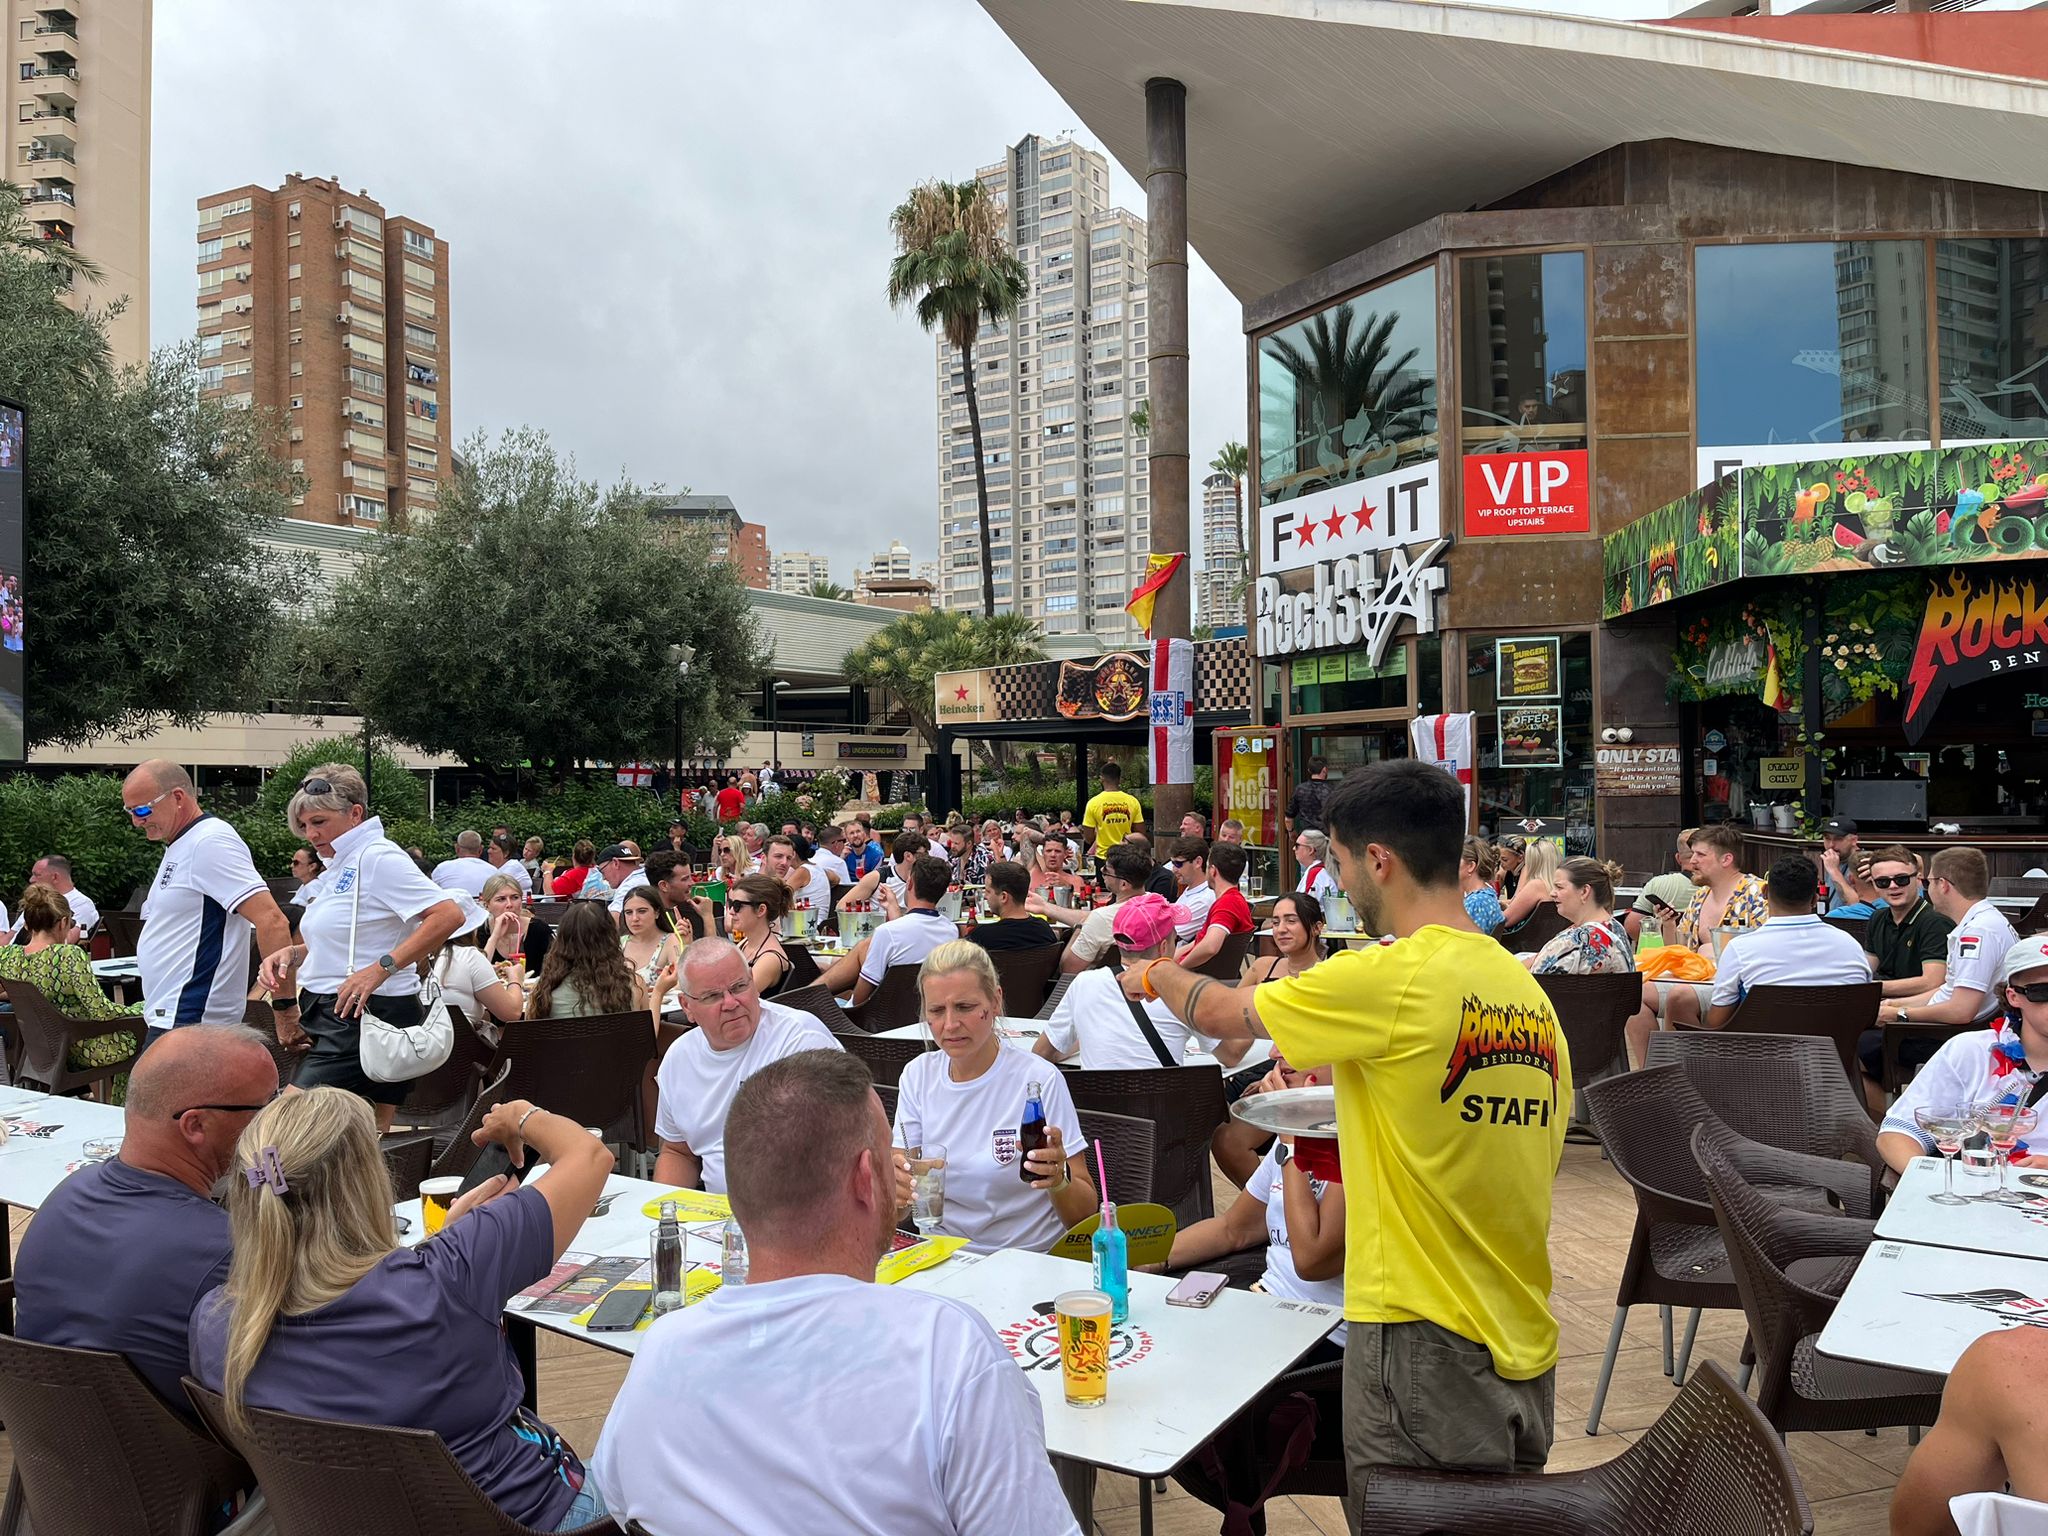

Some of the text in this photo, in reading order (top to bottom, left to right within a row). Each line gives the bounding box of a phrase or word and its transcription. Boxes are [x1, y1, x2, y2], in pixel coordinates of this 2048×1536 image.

[1480, 460, 1570, 505] VIP
[1478, 505, 1574, 517] VIP ROOF TOP TERRACE
[1507, 518, 1545, 527] UPSTAIRS
[939, 702, 986, 715] Heineken
[1511, 713, 1550, 725] OFFER
[1597, 748, 1680, 764] ONLY STA
[1767, 763, 1800, 771] STAFF
[1768, 775, 1798, 783] ONLY
[1106, 817, 1127, 825] STAFF
[1445, 995, 1559, 1098] ROCKSTAR
[1481, 1052, 1550, 1071] BENIDORM
